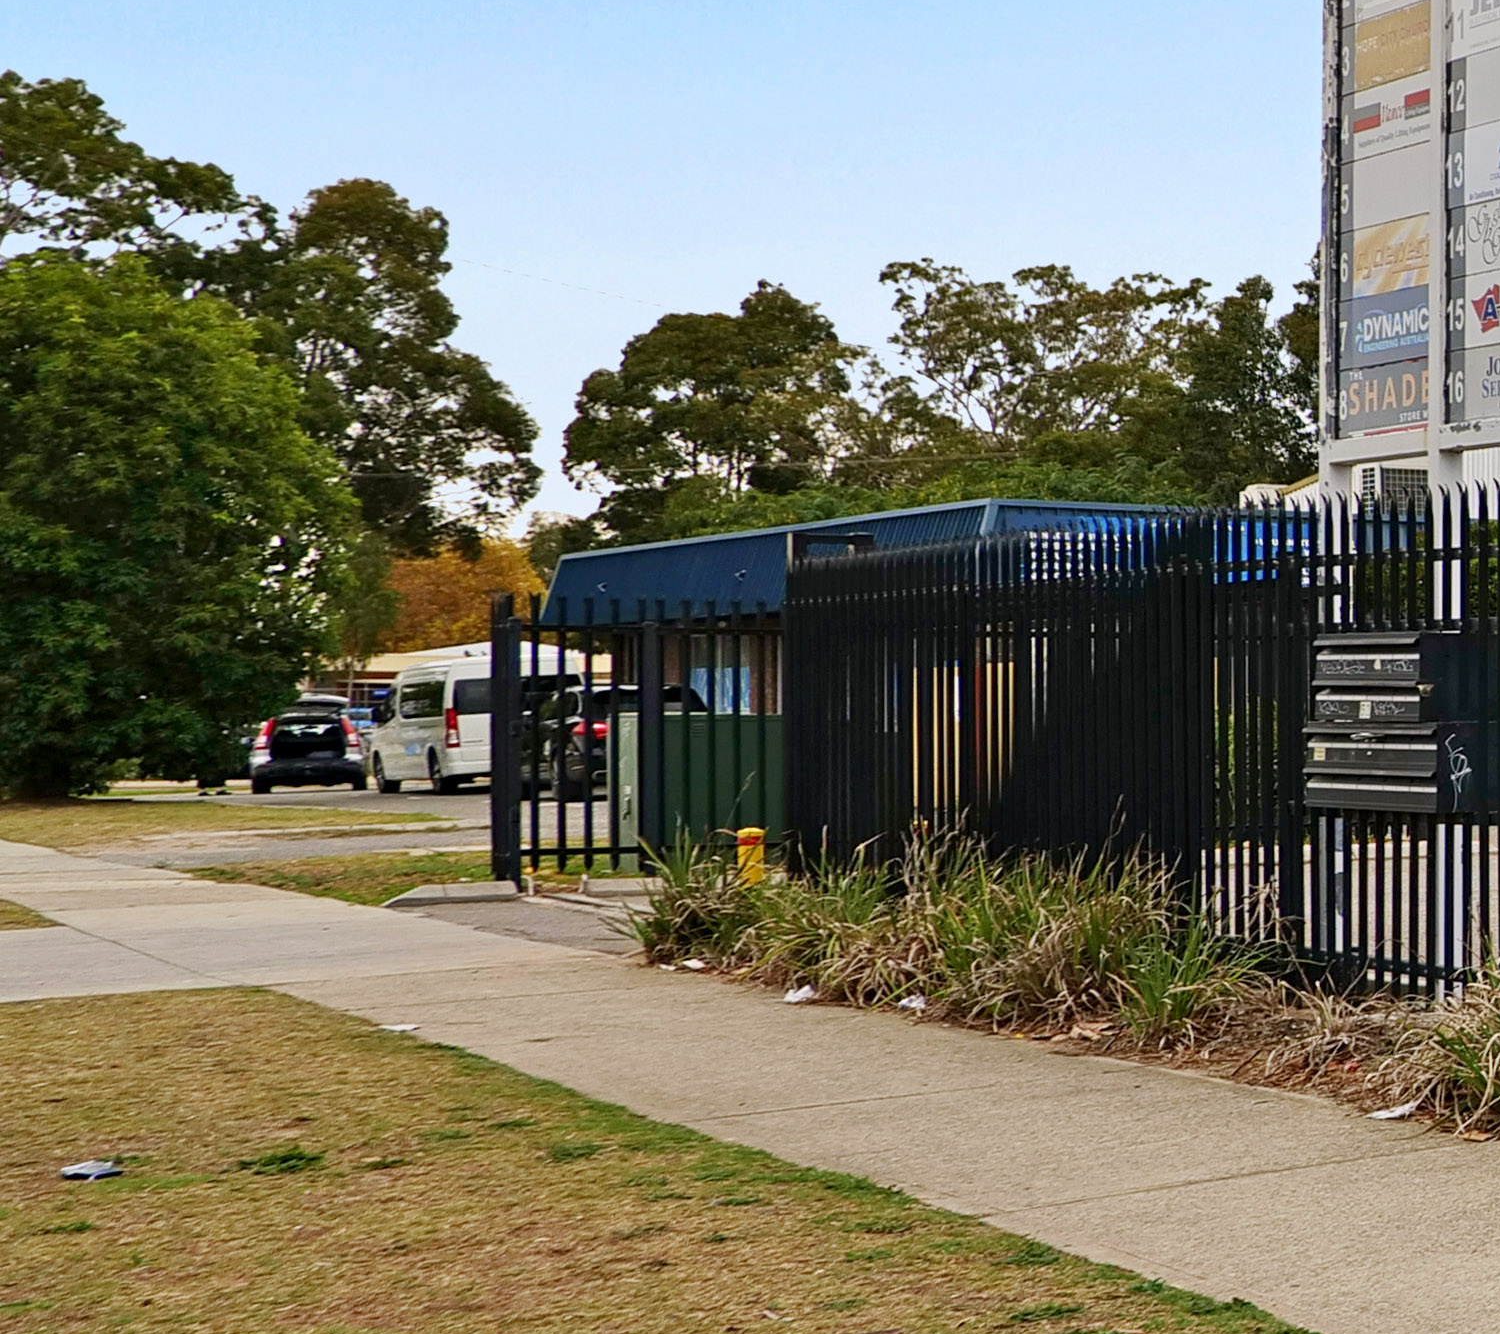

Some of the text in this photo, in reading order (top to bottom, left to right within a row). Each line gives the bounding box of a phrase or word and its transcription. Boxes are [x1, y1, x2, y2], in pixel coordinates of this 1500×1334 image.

[1342, 46, 1350, 77] 3
[1448, 79, 1465, 113] 12
[1341, 114, 1349, 144] 4
[1446, 152, 1463, 189] 13
[1341, 184, 1349, 215] 5
[1448, 225, 1465, 259] 14
[1341, 252, 1349, 283] 6
[1447, 297, 1464, 332] 15
[1339, 321, 1348, 353] 7
[1349, 370, 1364, 381] THE
[1447, 370, 1464, 404] 16
[1339, 390, 1348, 421] 8
[1348, 370, 1429, 415] SHADE
[1399, 410, 1421, 423] STORE
